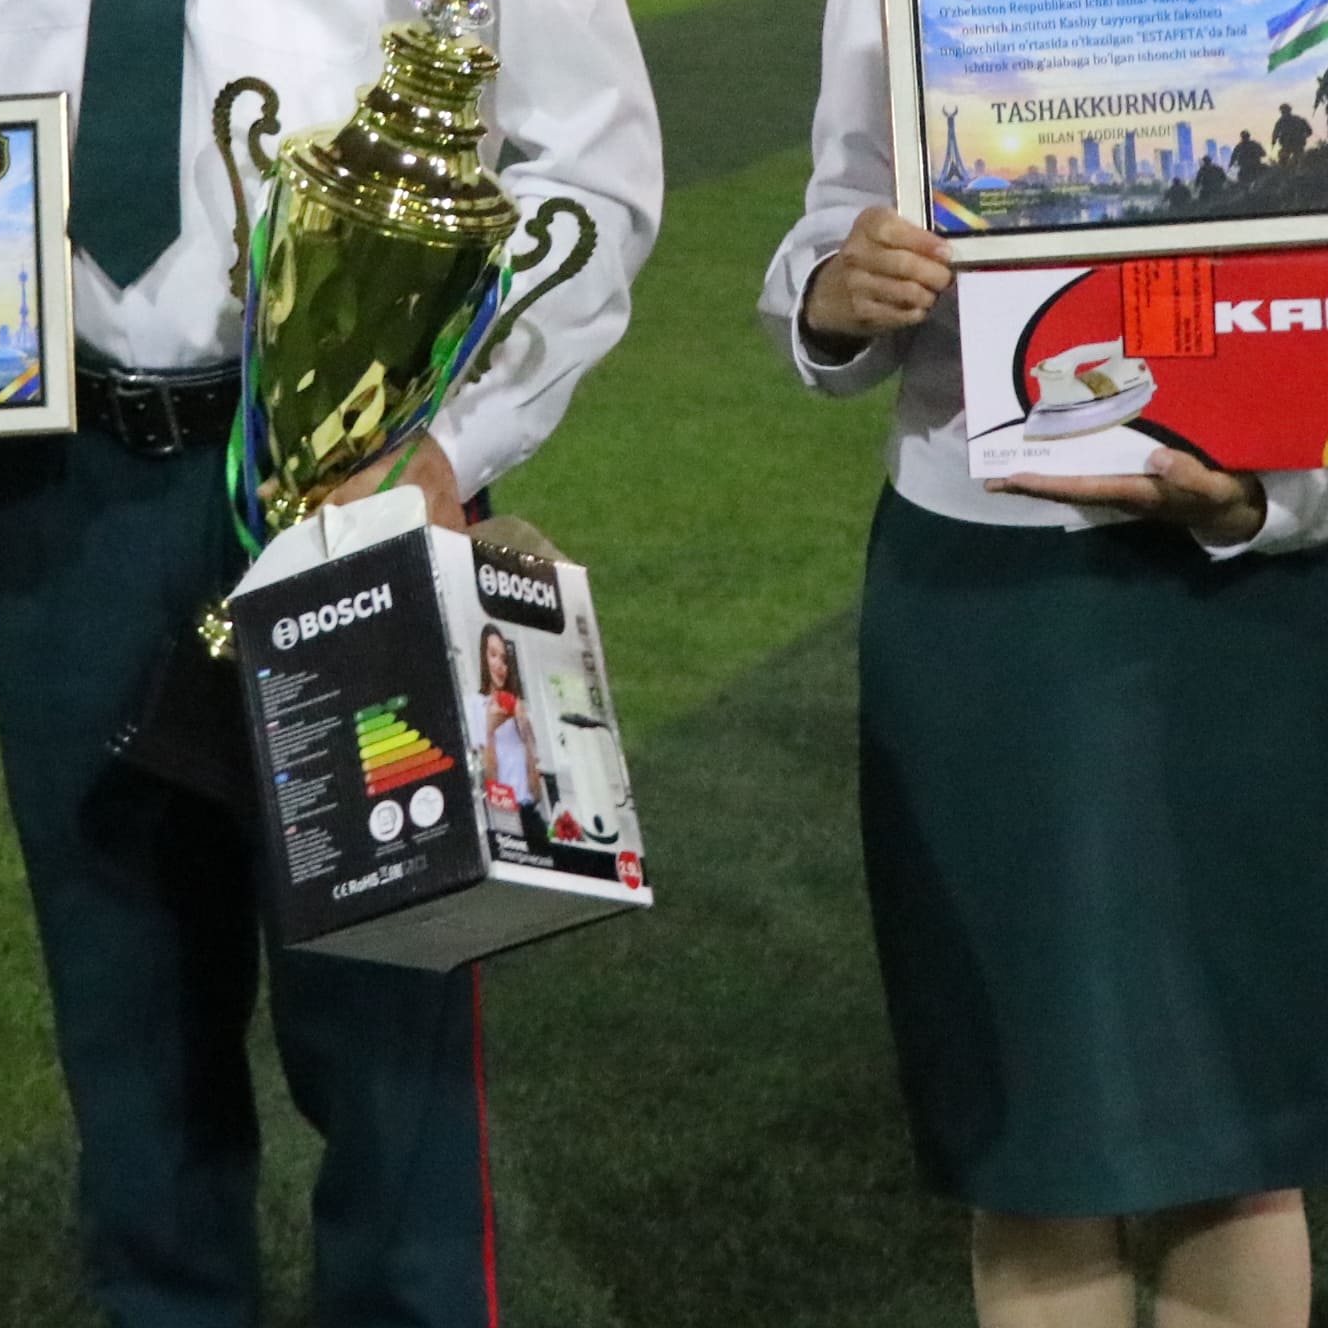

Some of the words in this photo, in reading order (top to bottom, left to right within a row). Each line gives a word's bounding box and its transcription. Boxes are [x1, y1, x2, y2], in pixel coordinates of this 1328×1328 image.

[991, 87, 1215, 124] TASHAKKURNOMA
[1038, 130, 1074, 144] BILAN
[497, 570, 557, 610] BOSCH
[299, 583, 392, 640] BOSCH
